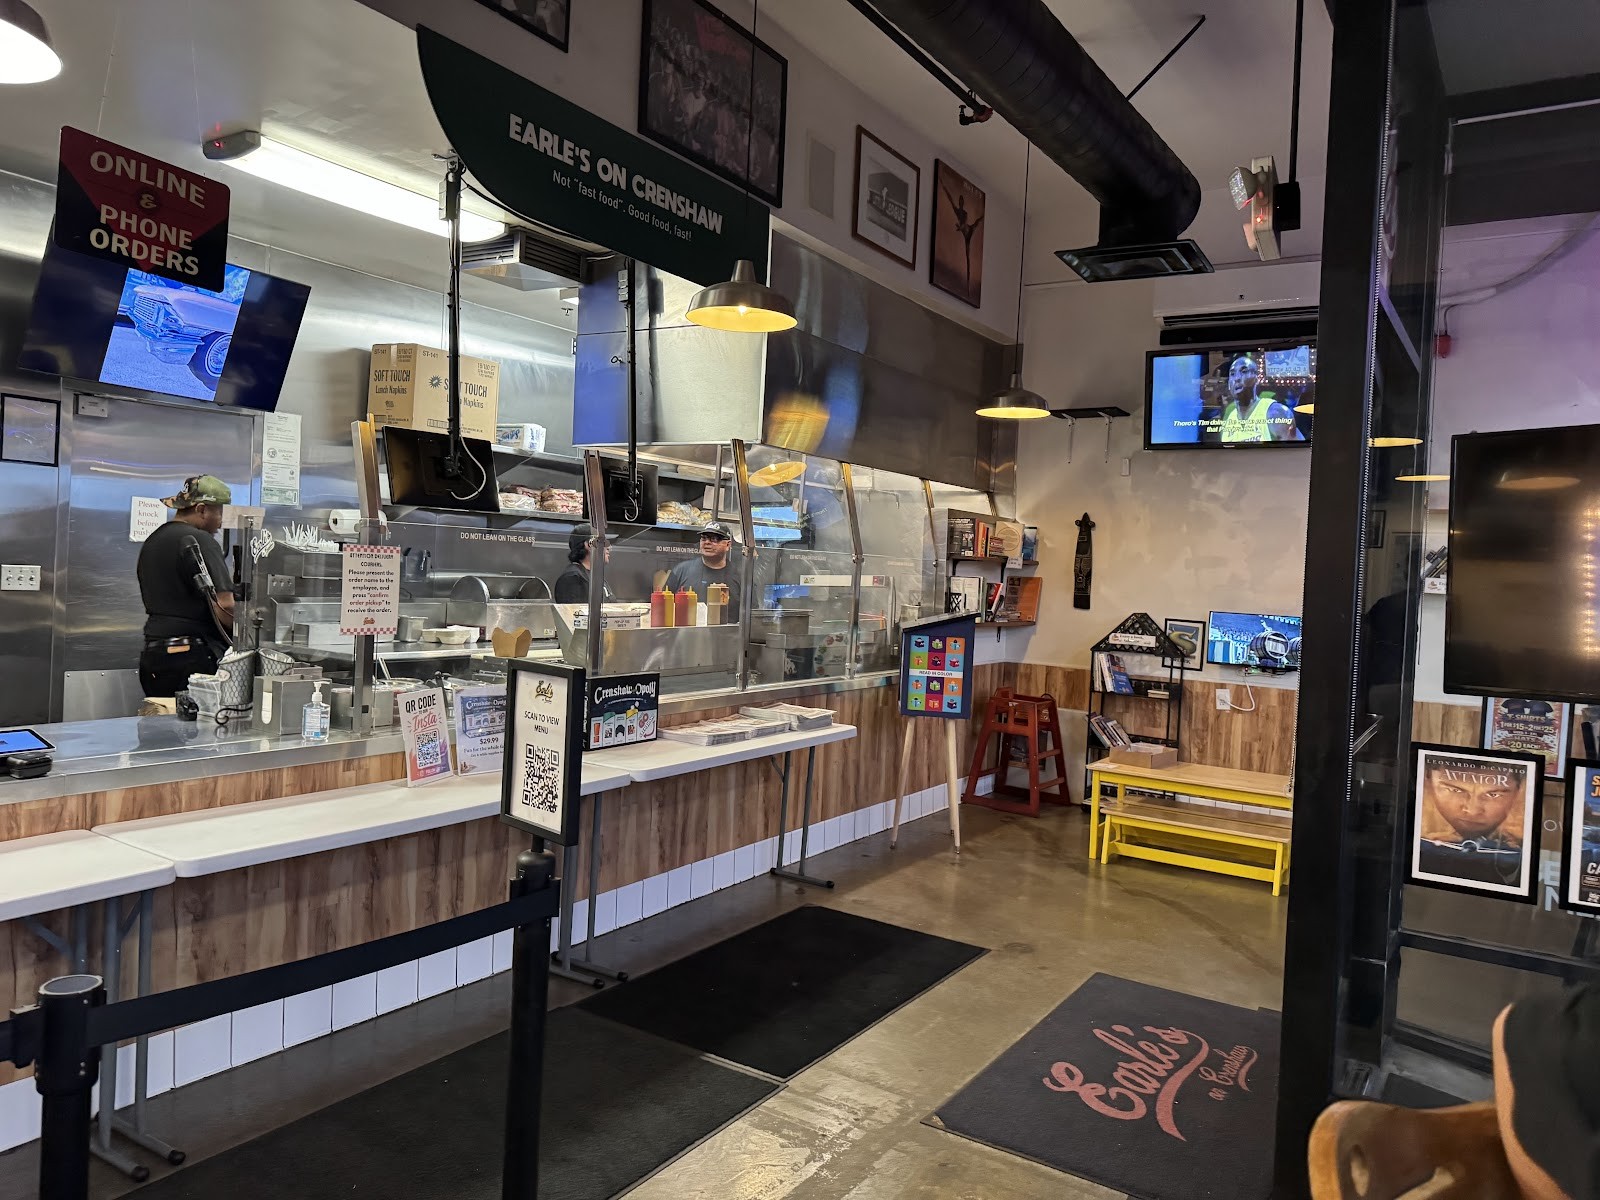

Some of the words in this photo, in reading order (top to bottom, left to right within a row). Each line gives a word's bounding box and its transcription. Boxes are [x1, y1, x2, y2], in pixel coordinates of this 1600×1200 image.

[89, 150, 206, 209] ONLINE
[509, 113, 591, 173] EARLE'S
[597, 157, 627, 190] ON
[632, 174, 723, 235] CRENSHAW
[139, 194, 157, 209] &
[552, 169, 571, 188] Not
[628, 204, 650, 223] Good
[652, 213, 672, 235] food,
[674, 223, 692, 242] fast!
[100, 203, 194, 251] PHONE
[89, 227, 200, 276] ORDERS
[374, 370, 390, 382] SOFT
[391, 370, 411, 382] TOUCH
[375, 385, 388, 394] Lunch
[389, 385, 407, 395] Napkins
[464, 382, 488, 398] TOUCH
[463, 397, 484, 408] Napkins
[1275, 417, 1293, 425] thing
[138, 500, 160, 509] Please
[138, 510, 159, 518] knock
[137, 519, 159, 527] before
[482, 533, 498, 541] LEAN
[405, 699, 416, 713] QR
[418, 694, 436, 710] CODE
[412, 711, 437, 731] Insta
[524, 711, 538, 721] SCAN
[539, 714, 545, 722] TO
[546, 716, 560, 725] VIEW
[534, 724, 549, 735] MENU
[1508, 740, 1522, 749] $20
[1426, 758, 1476, 769] LEONARDO
[1443, 768, 1509, 787] AVIATOR
